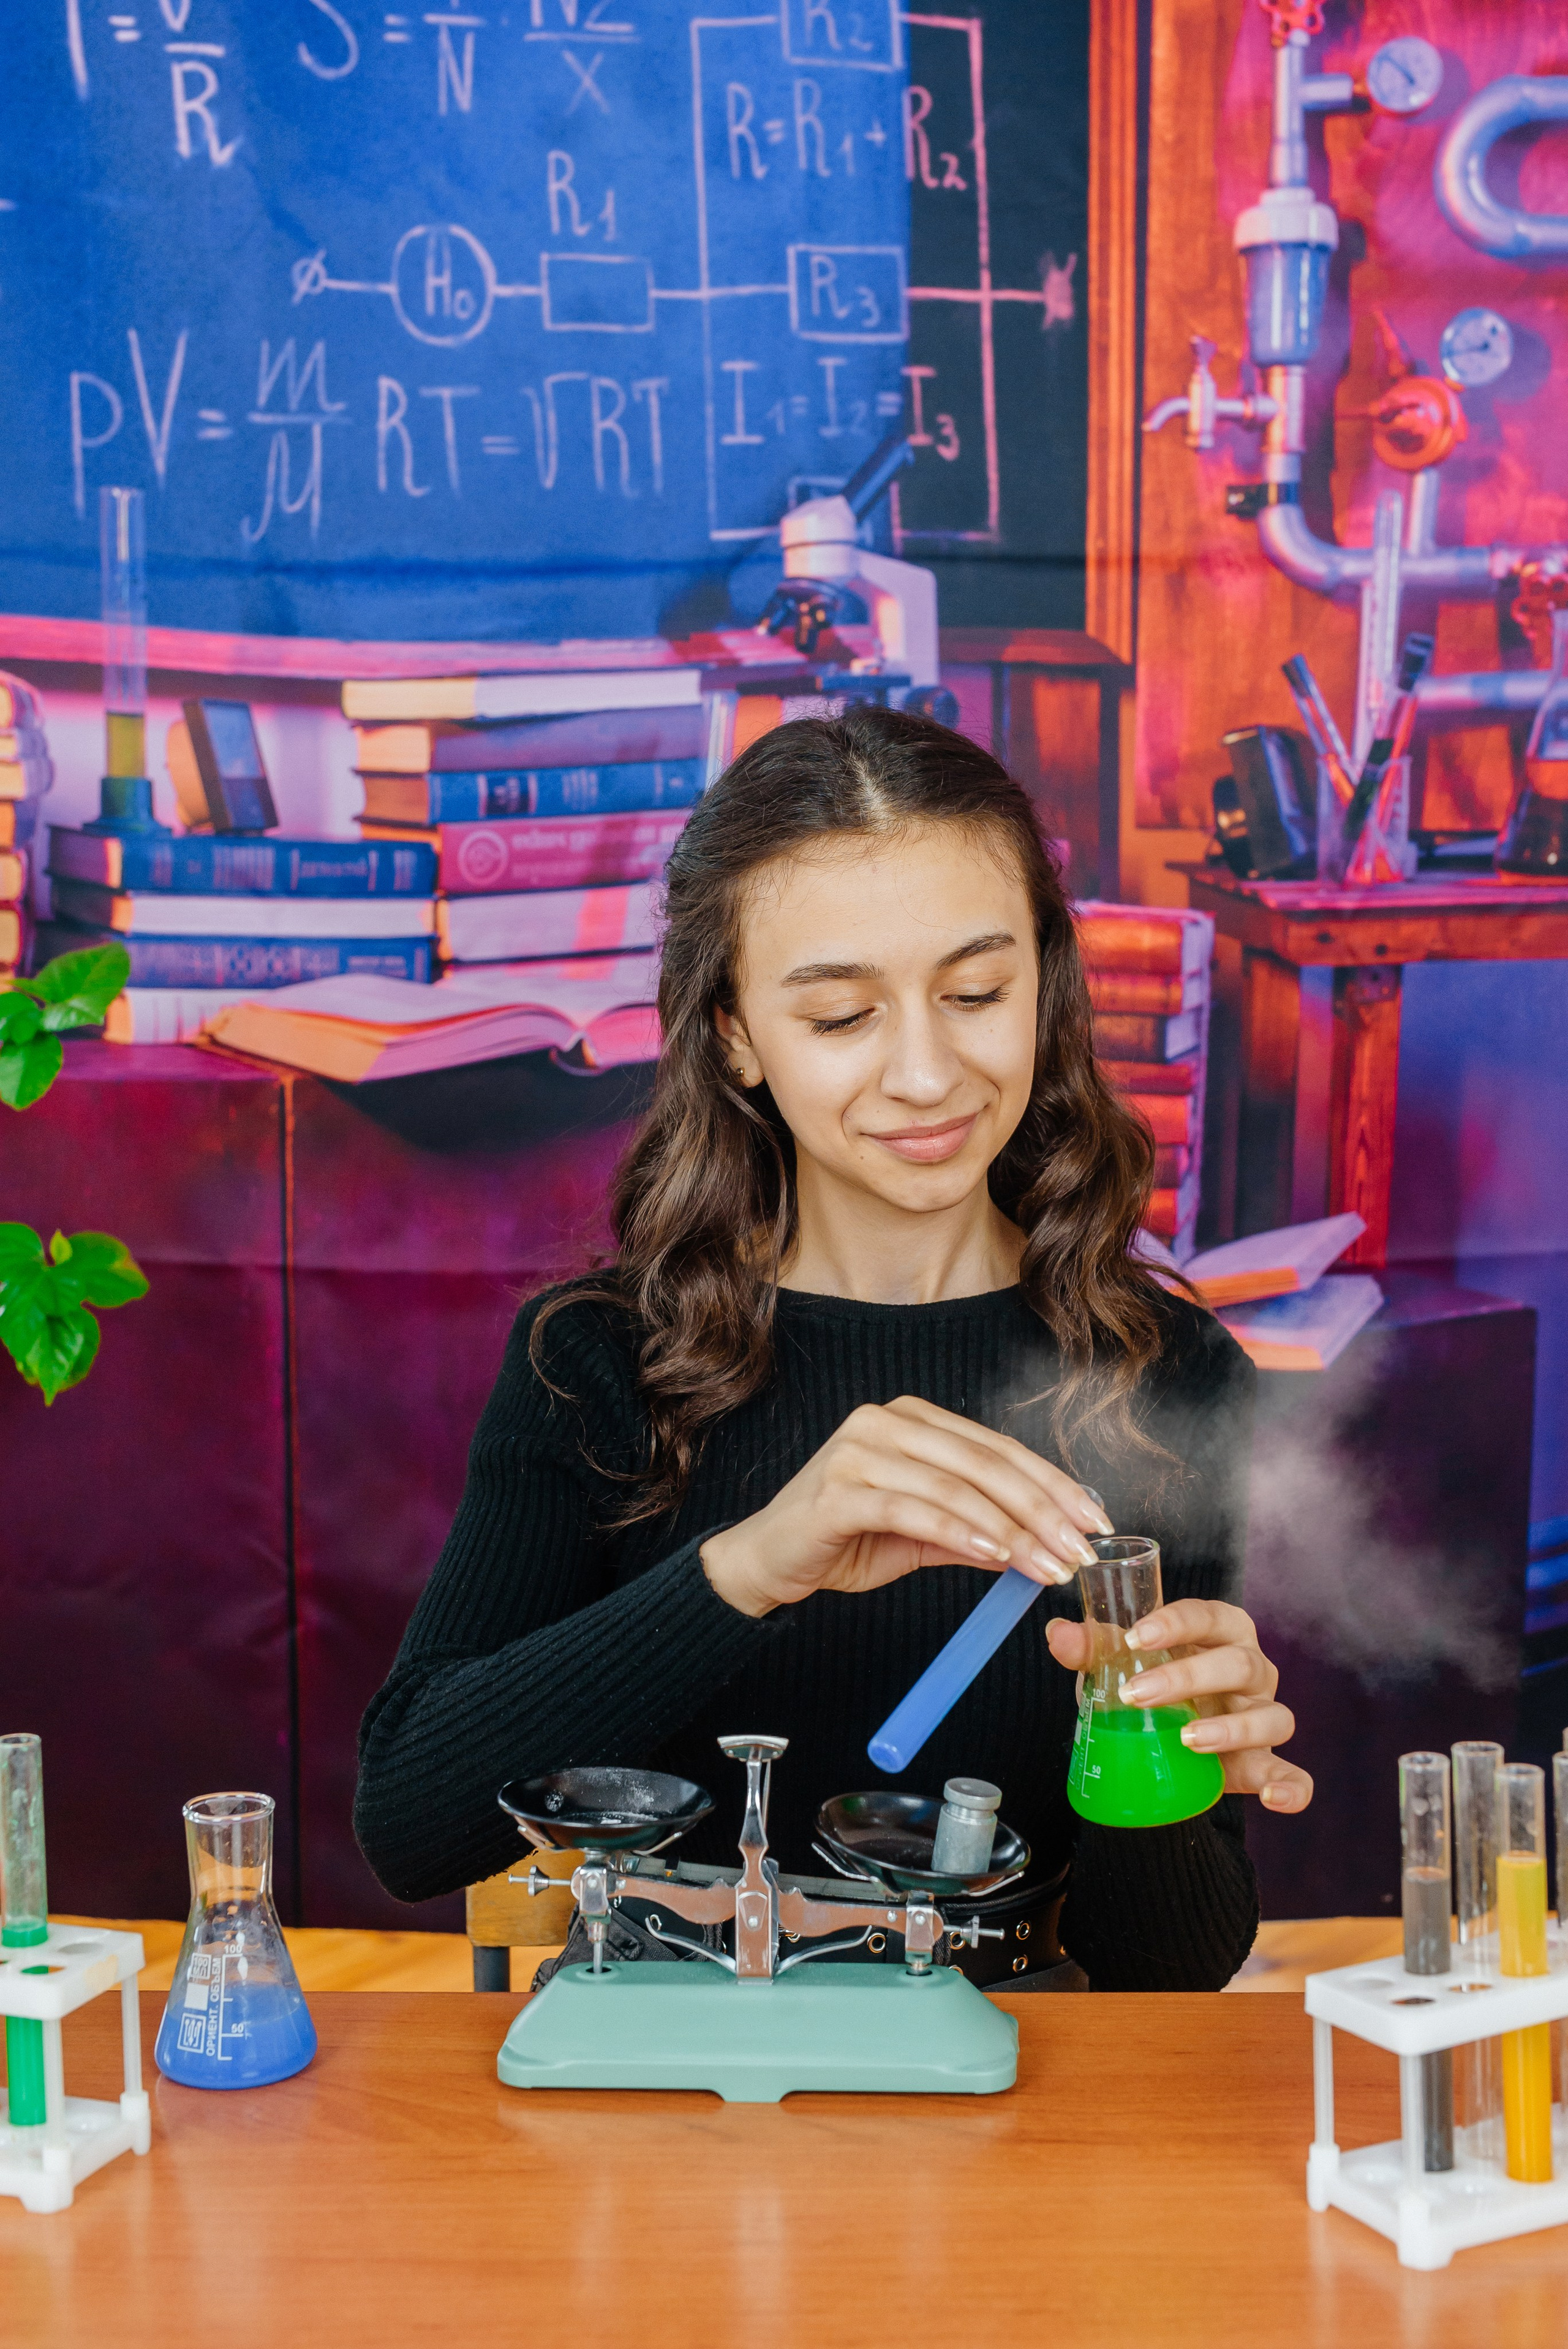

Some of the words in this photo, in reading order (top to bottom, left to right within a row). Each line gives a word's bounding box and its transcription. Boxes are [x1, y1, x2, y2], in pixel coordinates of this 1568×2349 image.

[171, 61, 244, 167] R
[1092, 1688, 1106, 1699] 100
[1092, 1765, 1101, 1774] 50
[224, 1944, 243, 1954] 100
